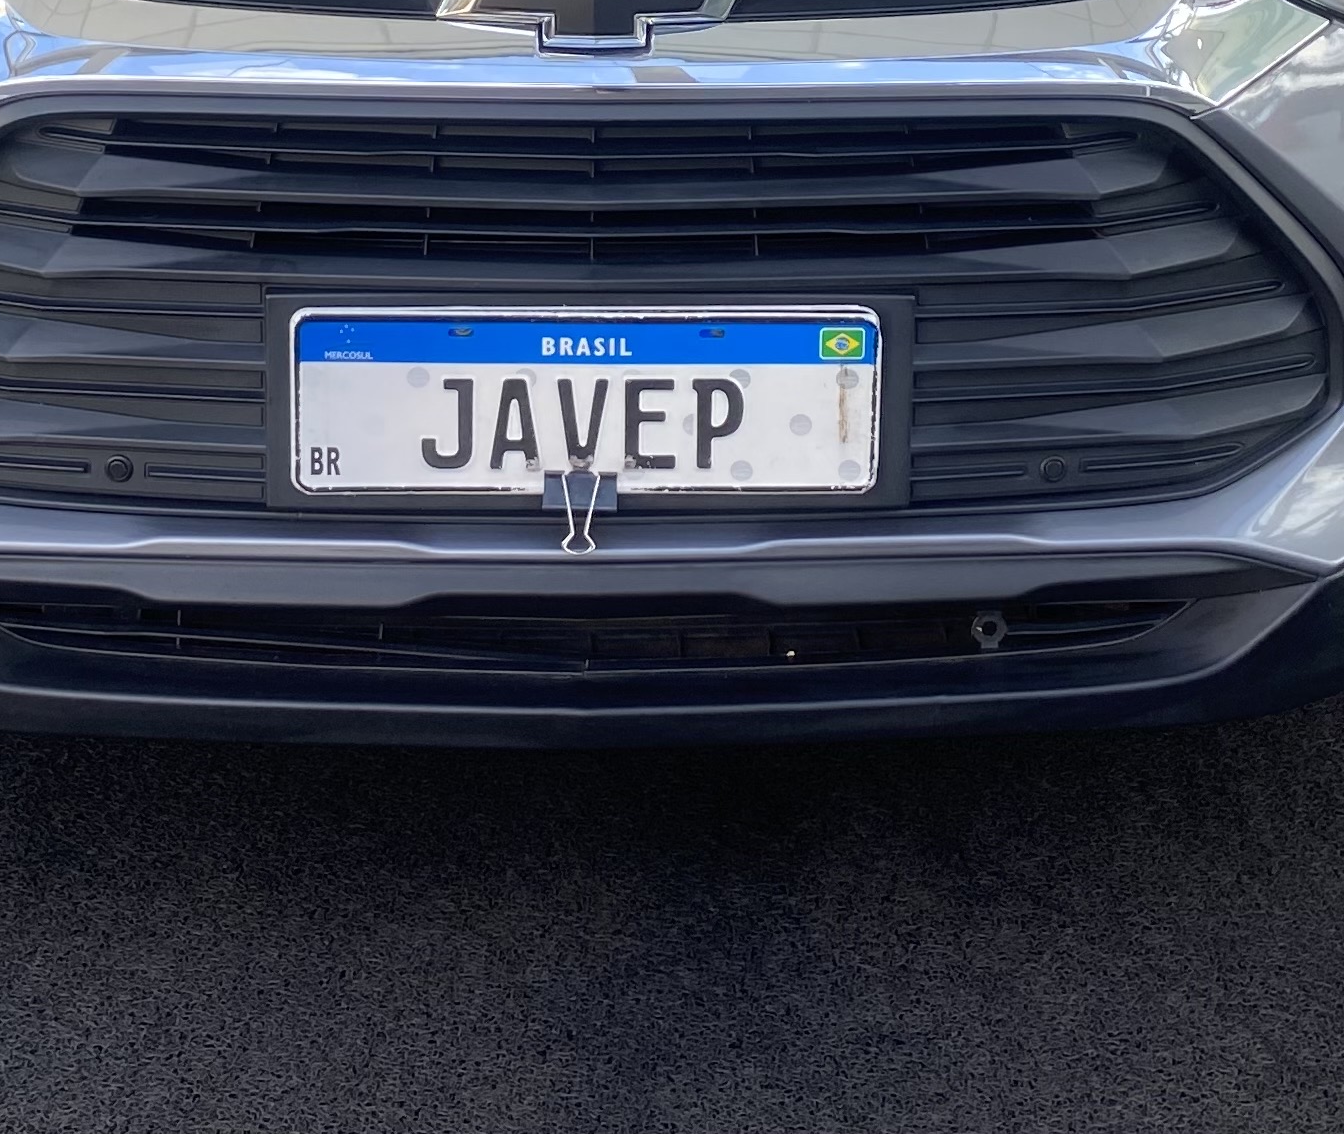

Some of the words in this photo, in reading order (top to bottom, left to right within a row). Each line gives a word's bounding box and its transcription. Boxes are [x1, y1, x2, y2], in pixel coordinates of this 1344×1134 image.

[324, 350, 374, 360] MERCOSUL
[541, 336, 633, 358] BRASIL
[420, 377, 746, 471] JAVEP
[309, 446, 341, 476] BR
